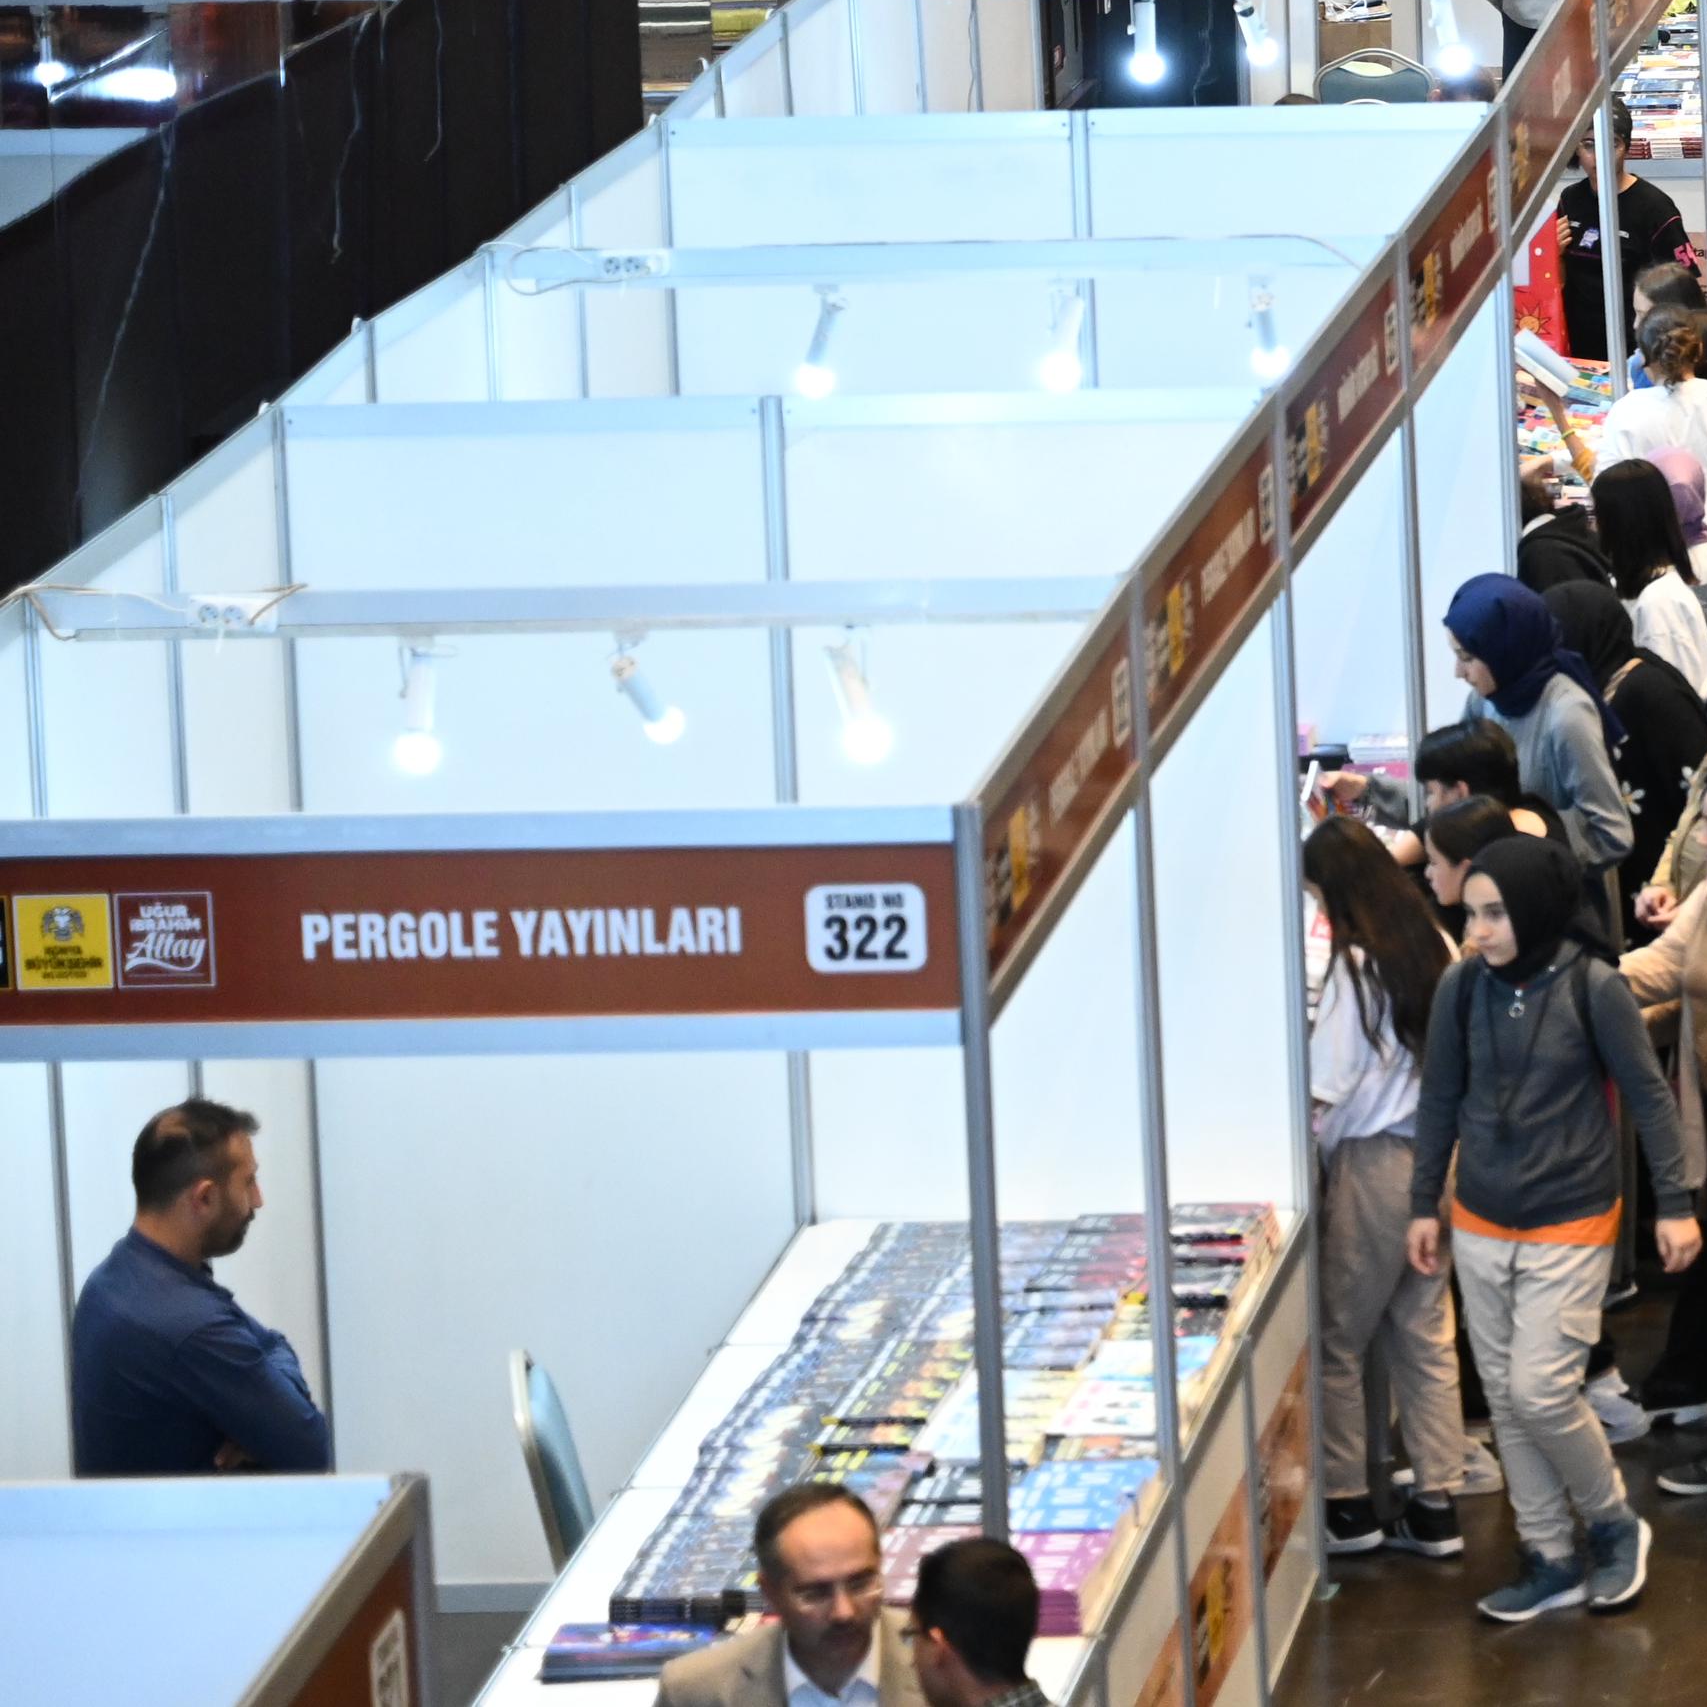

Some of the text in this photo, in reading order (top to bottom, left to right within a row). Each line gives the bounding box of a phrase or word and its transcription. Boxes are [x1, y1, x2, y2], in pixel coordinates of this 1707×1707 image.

[301, 904, 742, 961] PERGOLE YAYINLARI
[823, 913, 909, 962] 322
